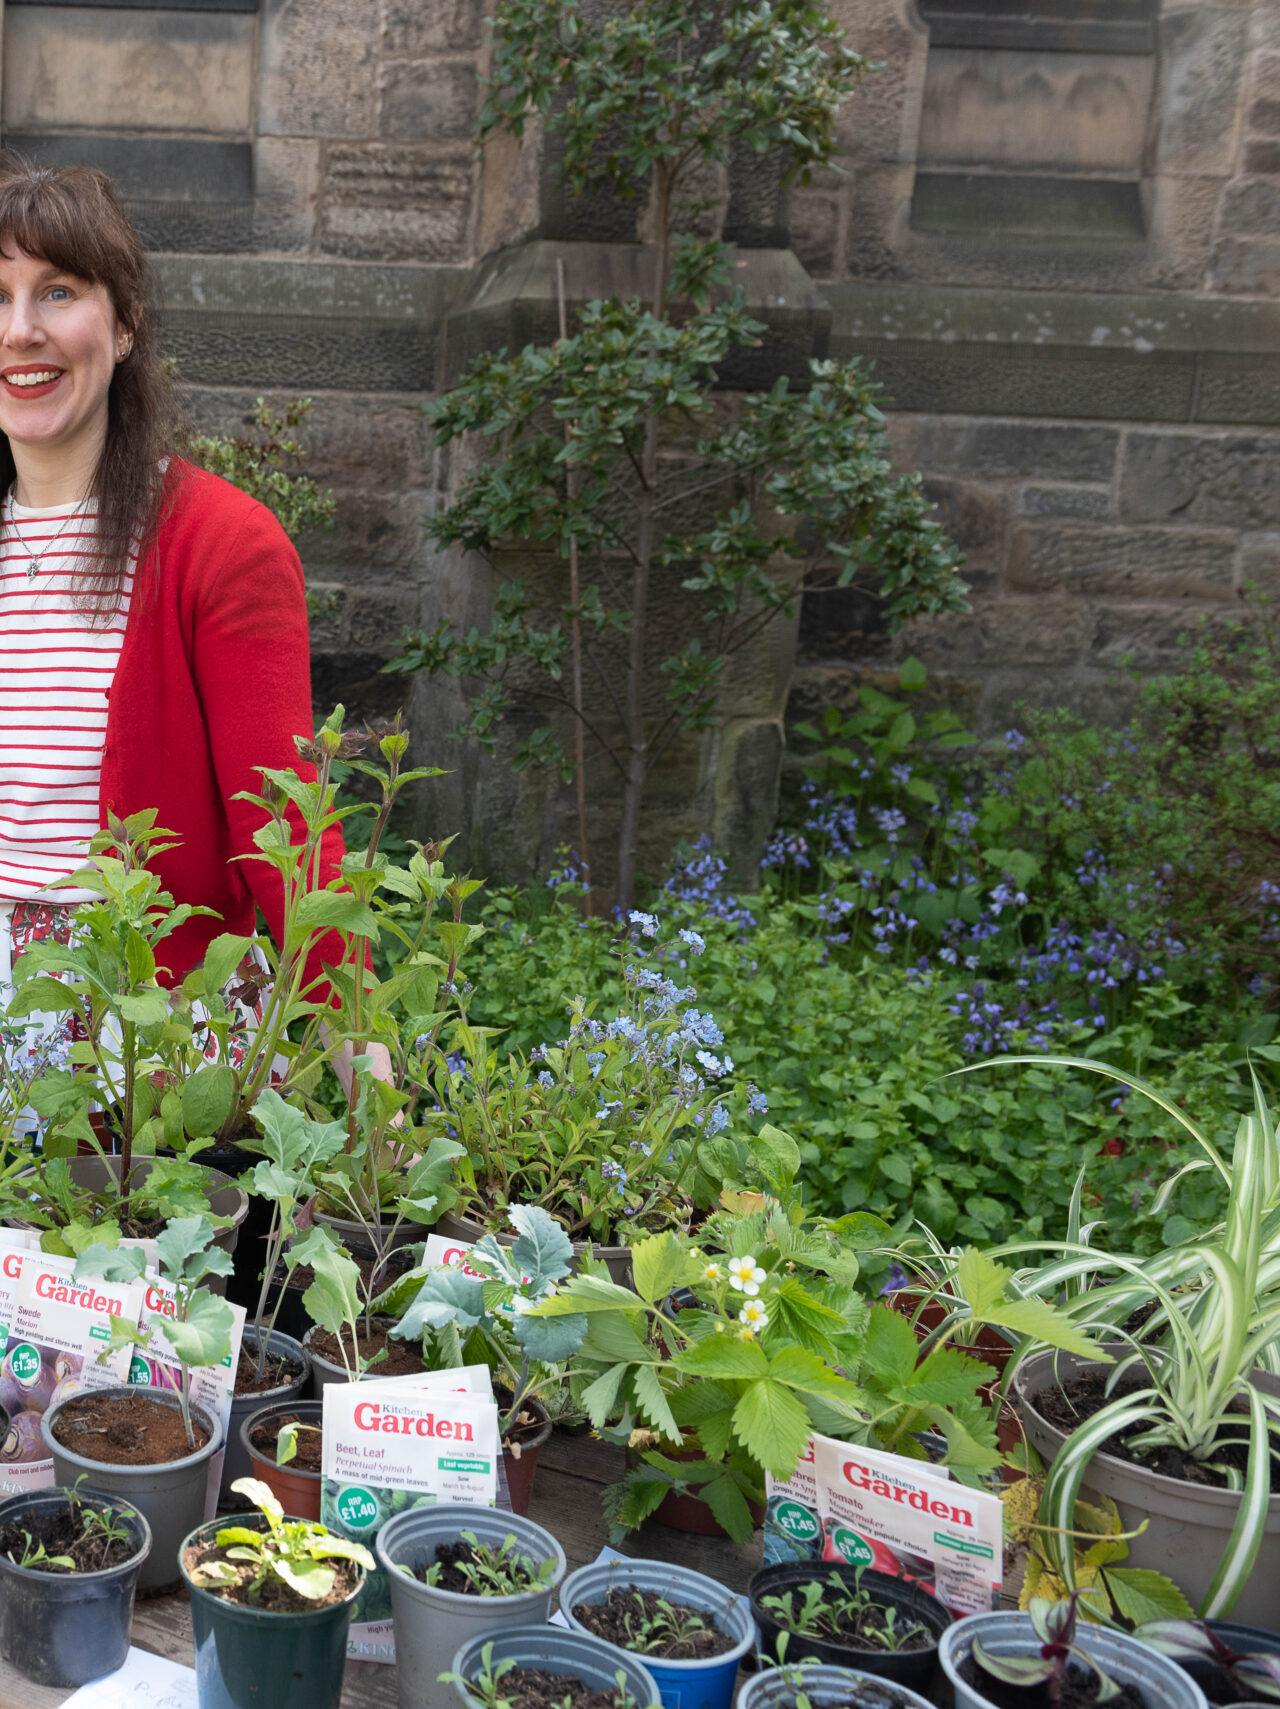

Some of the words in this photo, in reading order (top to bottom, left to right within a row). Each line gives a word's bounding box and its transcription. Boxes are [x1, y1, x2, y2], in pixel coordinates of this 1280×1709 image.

[58, 1277, 88, 1291] Kitchen
[36, 1274, 122, 1316] Garden
[18, 1306, 41, 1318] Swede
[16, 1318, 38, 1329] Marion
[14, 1327, 24, 1336] High
[25, 1330, 44, 1341] yielding
[45, 1335, 54, 1343] and
[55, 1338, 70, 1347] stores
[72, 1341, 82, 1350] well
[14, 1359, 38, 1371] £1.35
[130, 1372, 148, 1384] 1.55
[383, 1404, 422, 1416] Kitchen
[354, 1402, 474, 1441] Garden
[336, 1443, 360, 1457] Beet,
[363, 1447, 385, 1458] Leaf
[336, 1457, 376, 1470] Perpetual
[378, 1462, 413, 1474] Spinach
[444, 1459, 456, 1468] Leaf
[370, 1474, 404, 1484] mid-green
[406, 1478, 428, 1486] leaves
[872, 1469, 916, 1491] Kitchen
[773, 1485, 793, 1495] Crops
[843, 1461, 973, 1527] Garden
[348, 1496, 362, 1506] RRP
[827, 1487, 863, 1510] Tomato
[341, 1502, 376, 1520] £1.40
[787, 1510, 801, 1519] RRP
[828, 1500, 884, 1529] Moneymaker
[781, 1517, 815, 1531] £1.45
[858, 1522, 872, 1534] very
[874, 1529, 902, 1545] popular
[904, 1540, 928, 1554] choice
[839, 1544, 870, 1559] £1.45
[368, 1626, 383, 1634] High
